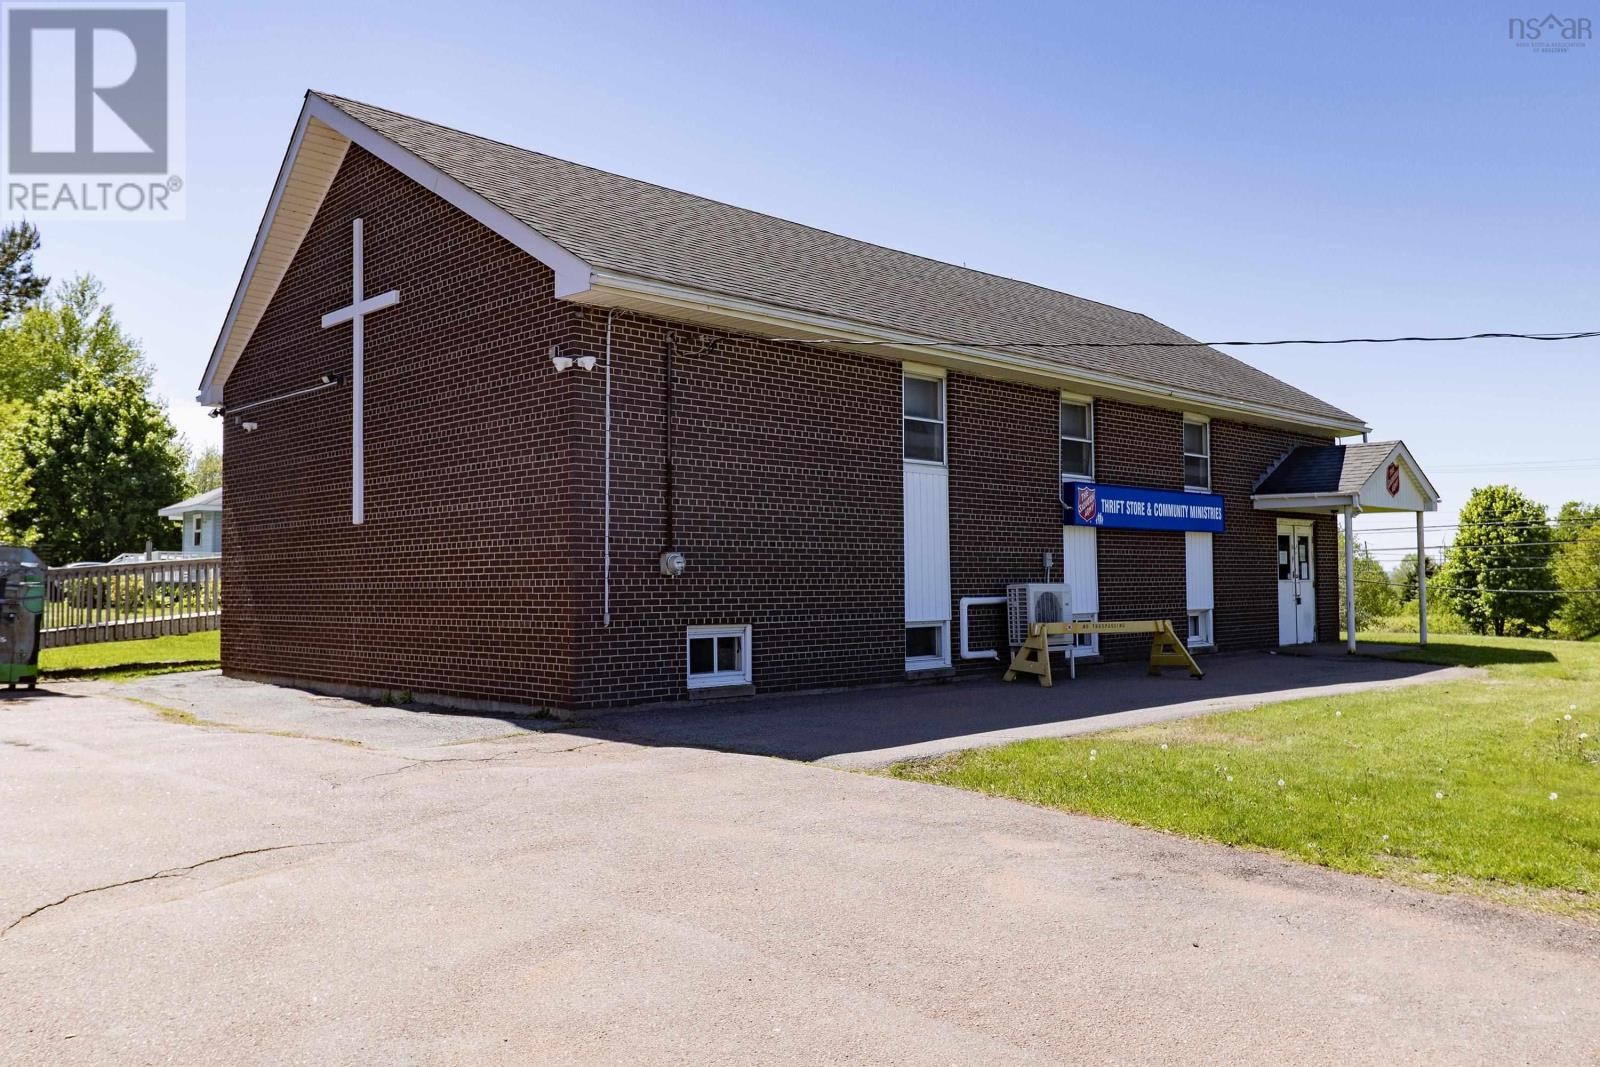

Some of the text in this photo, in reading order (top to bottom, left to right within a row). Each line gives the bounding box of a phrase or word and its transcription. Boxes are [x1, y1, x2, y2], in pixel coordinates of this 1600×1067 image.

[1101, 498, 1222, 521] THRIFT STORE & COMMUNITY MINISTRIES
